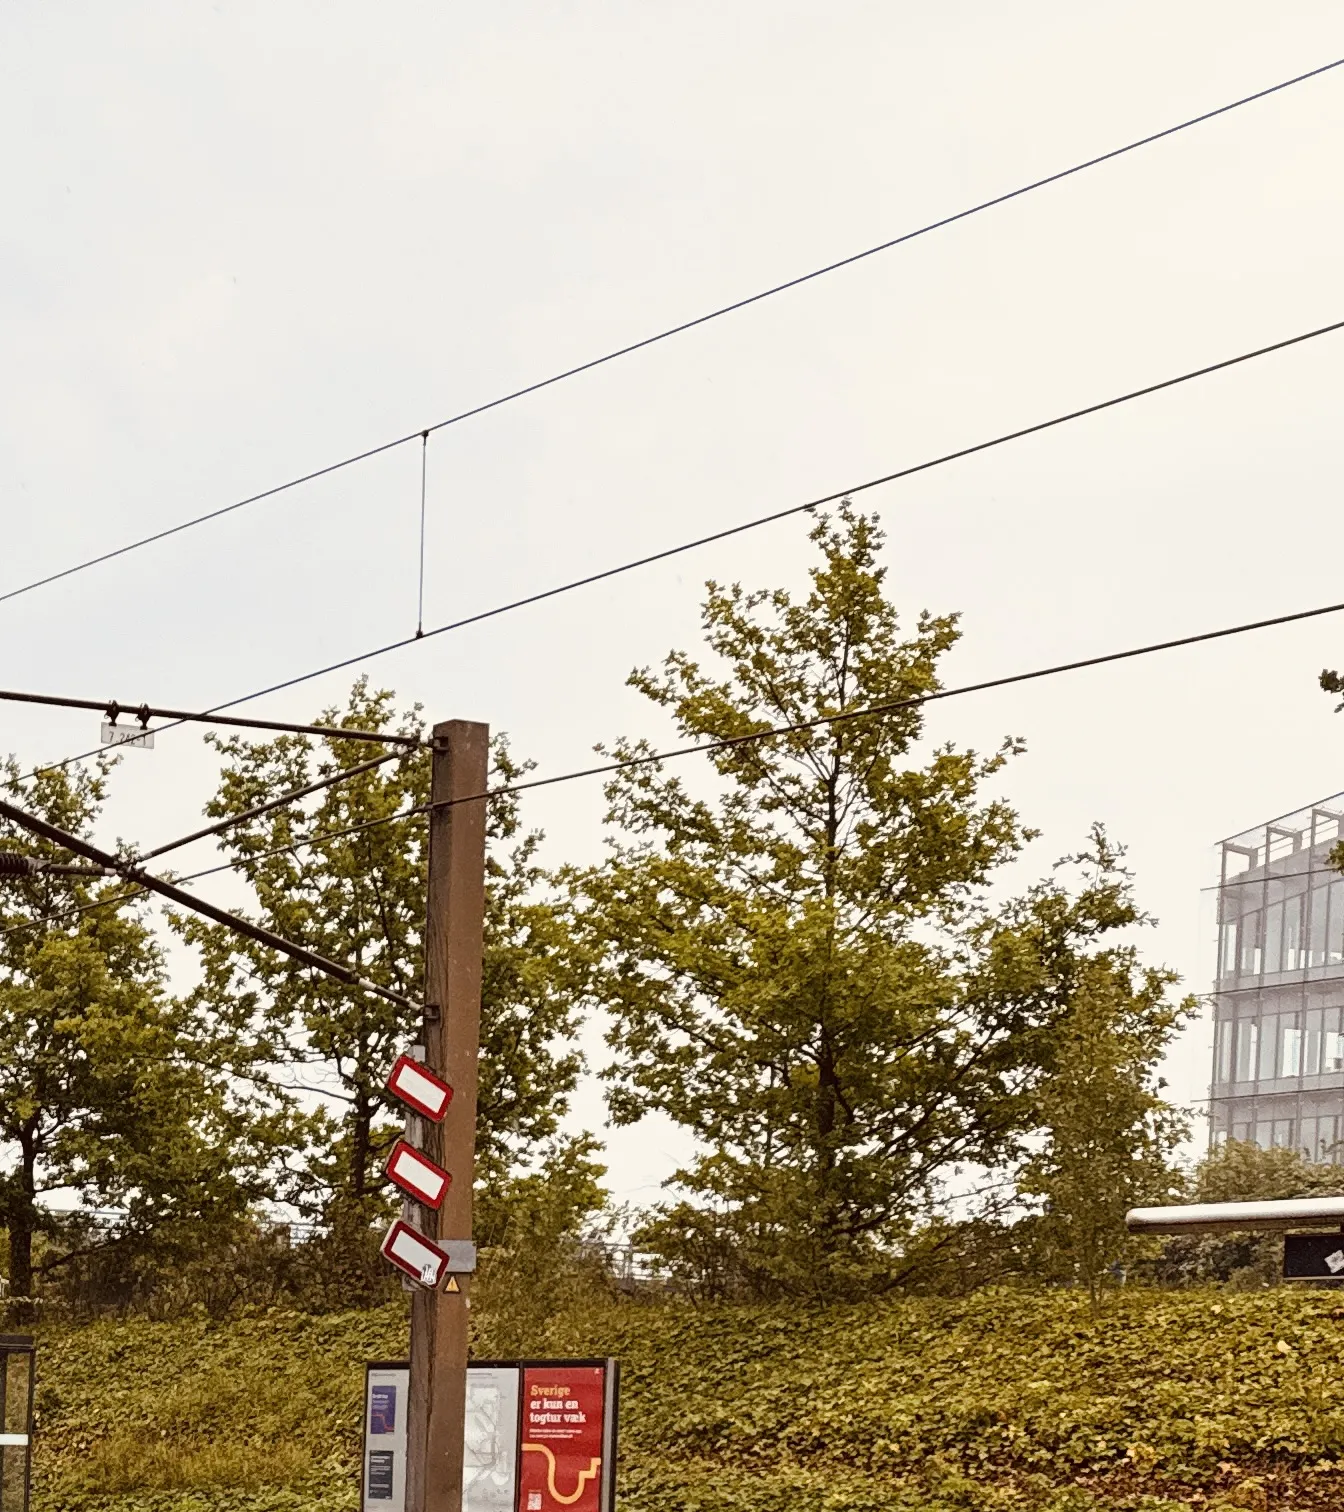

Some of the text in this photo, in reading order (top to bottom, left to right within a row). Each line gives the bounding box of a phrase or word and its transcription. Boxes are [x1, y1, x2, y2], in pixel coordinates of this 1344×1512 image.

[530, 1384, 571, 1398] Sverige
[530, 1398, 579, 1410] er kun en
[529, 1411, 587, 1425] togtur væk
